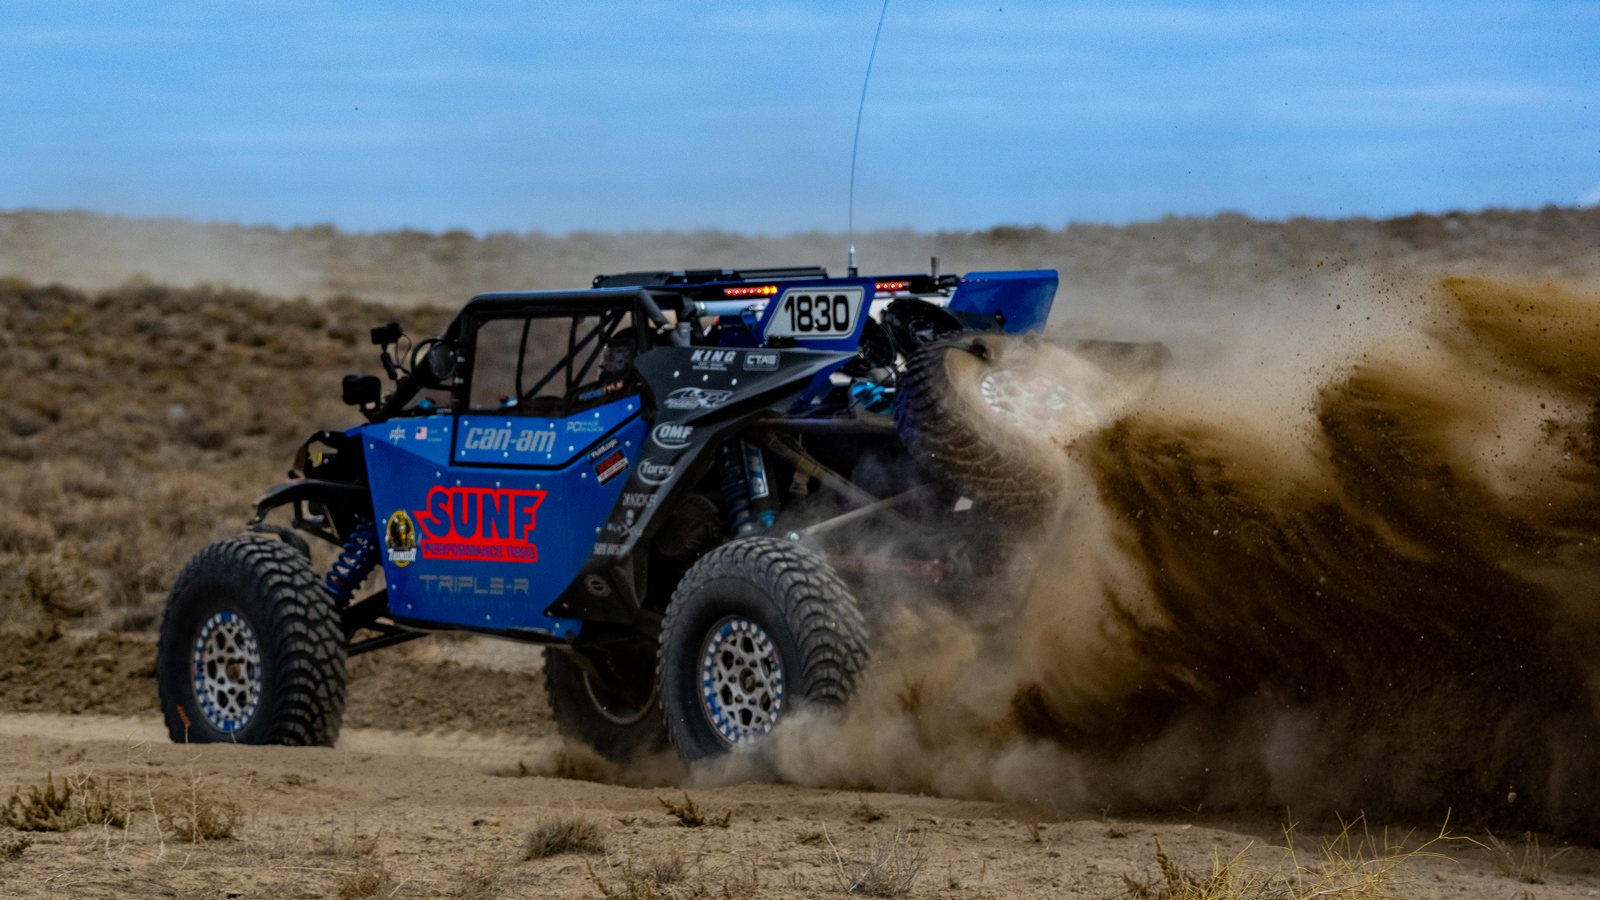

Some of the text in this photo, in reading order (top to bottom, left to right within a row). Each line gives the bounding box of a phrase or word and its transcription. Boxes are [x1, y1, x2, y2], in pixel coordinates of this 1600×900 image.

[784, 295, 849, 332] 1830
[690, 350, 737, 364] KING
[464, 427, 556, 453] can-am
[659, 425, 694, 439] OMF
[415, 485, 548, 542] SUNF
[423, 543, 536, 559] PERFORMANCE TIRES
[419, 575, 529, 596] TRIPLE-R
